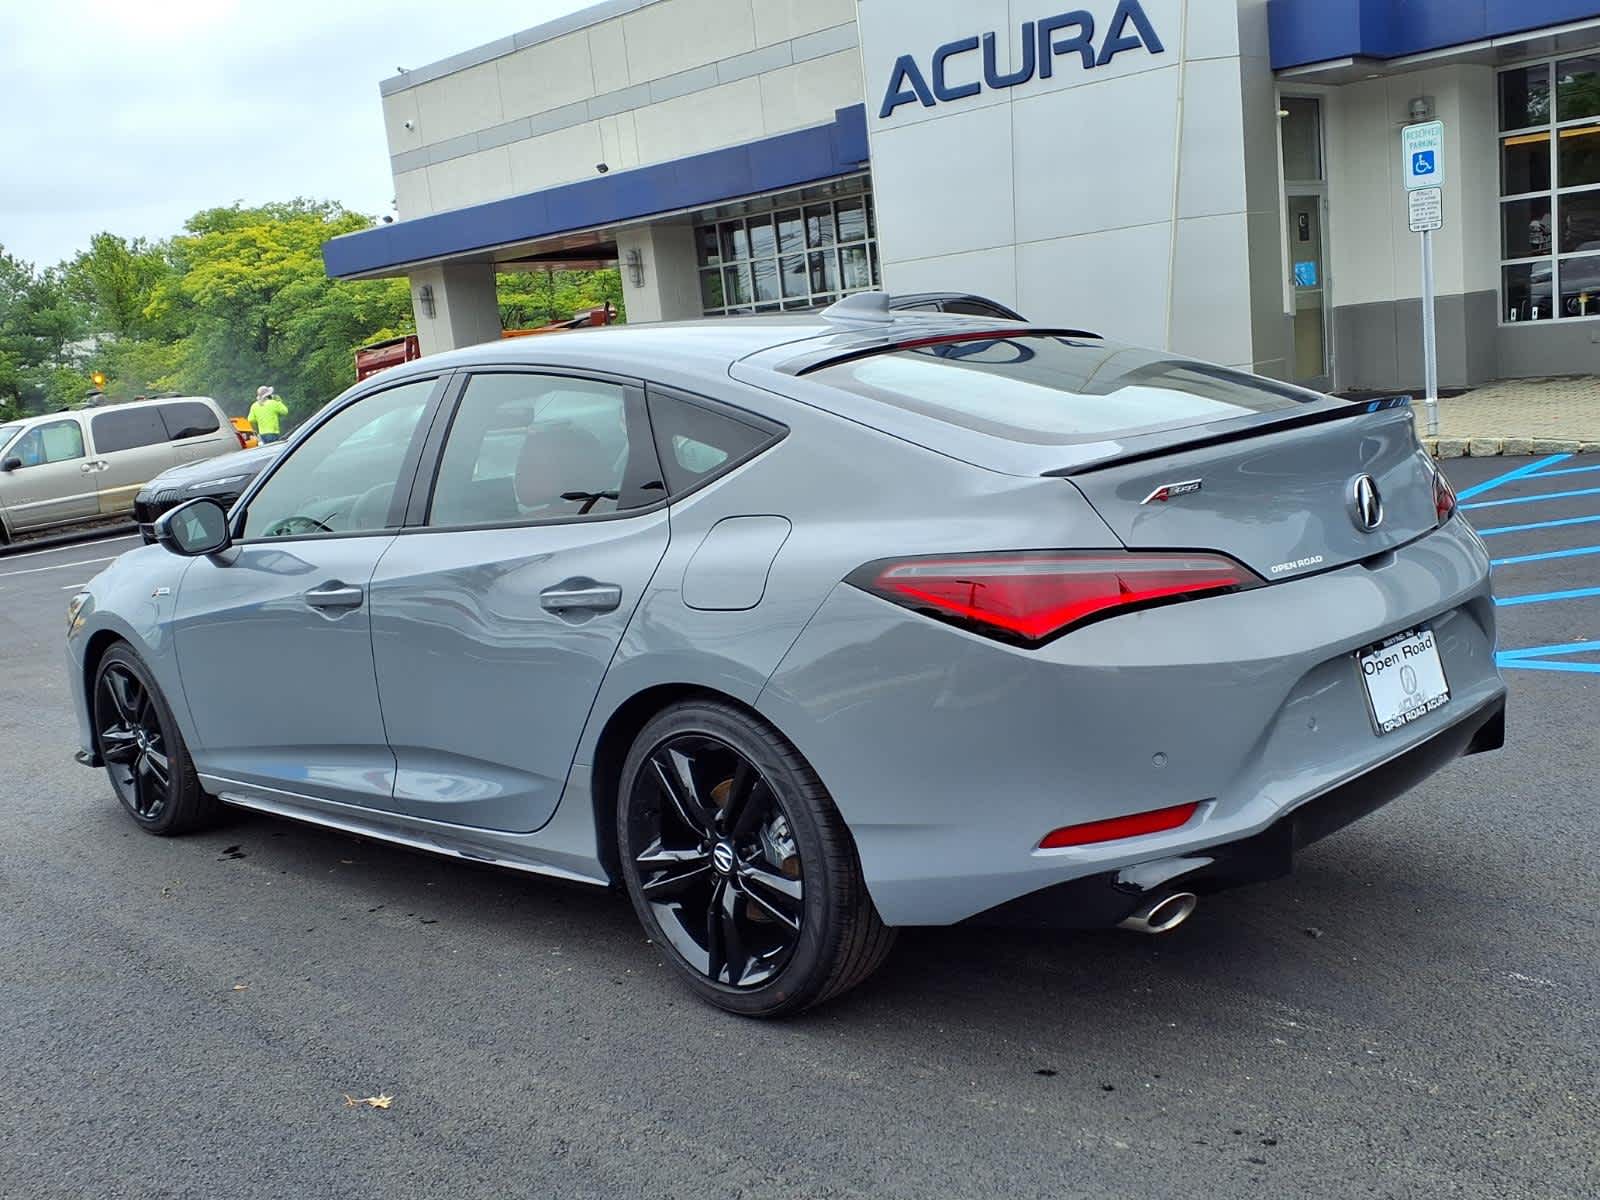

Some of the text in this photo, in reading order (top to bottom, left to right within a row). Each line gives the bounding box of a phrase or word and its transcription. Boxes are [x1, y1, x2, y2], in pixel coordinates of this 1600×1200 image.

[879, 0, 1165, 118] ACURA
[1271, 555, 1323, 573] OPEN ROAD
[1363, 652, 1400, 676] Open
[1402, 636, 1433, 659] Road
[1383, 715, 1406, 732] OPEN
[1405, 706, 1427, 721] ROAD
[1427, 693, 1449, 711] ACURA
